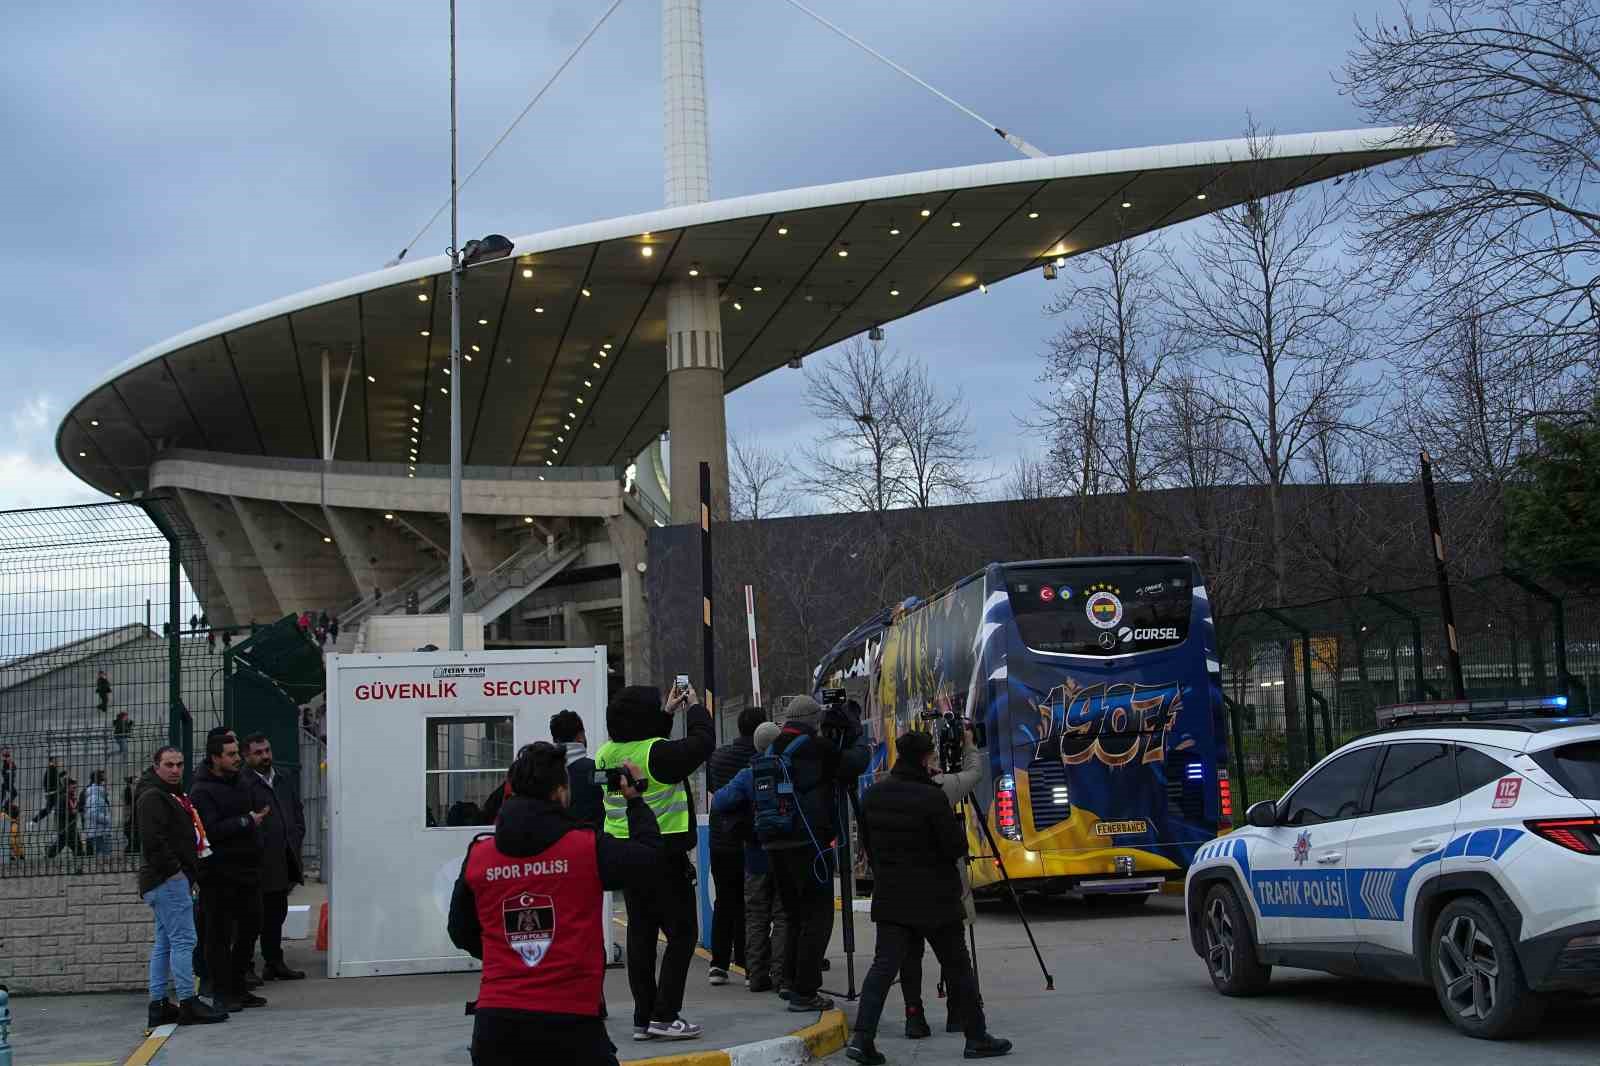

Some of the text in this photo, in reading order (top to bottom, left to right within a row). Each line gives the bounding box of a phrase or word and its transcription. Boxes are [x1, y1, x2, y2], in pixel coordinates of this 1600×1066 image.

[355, 678, 581, 700] GÜVENLİK SECURITY
[1499, 782, 1518, 796] 112
[486, 864, 521, 881] SPOR
[1258, 875, 1345, 907] TRAFİK POLİSİ
